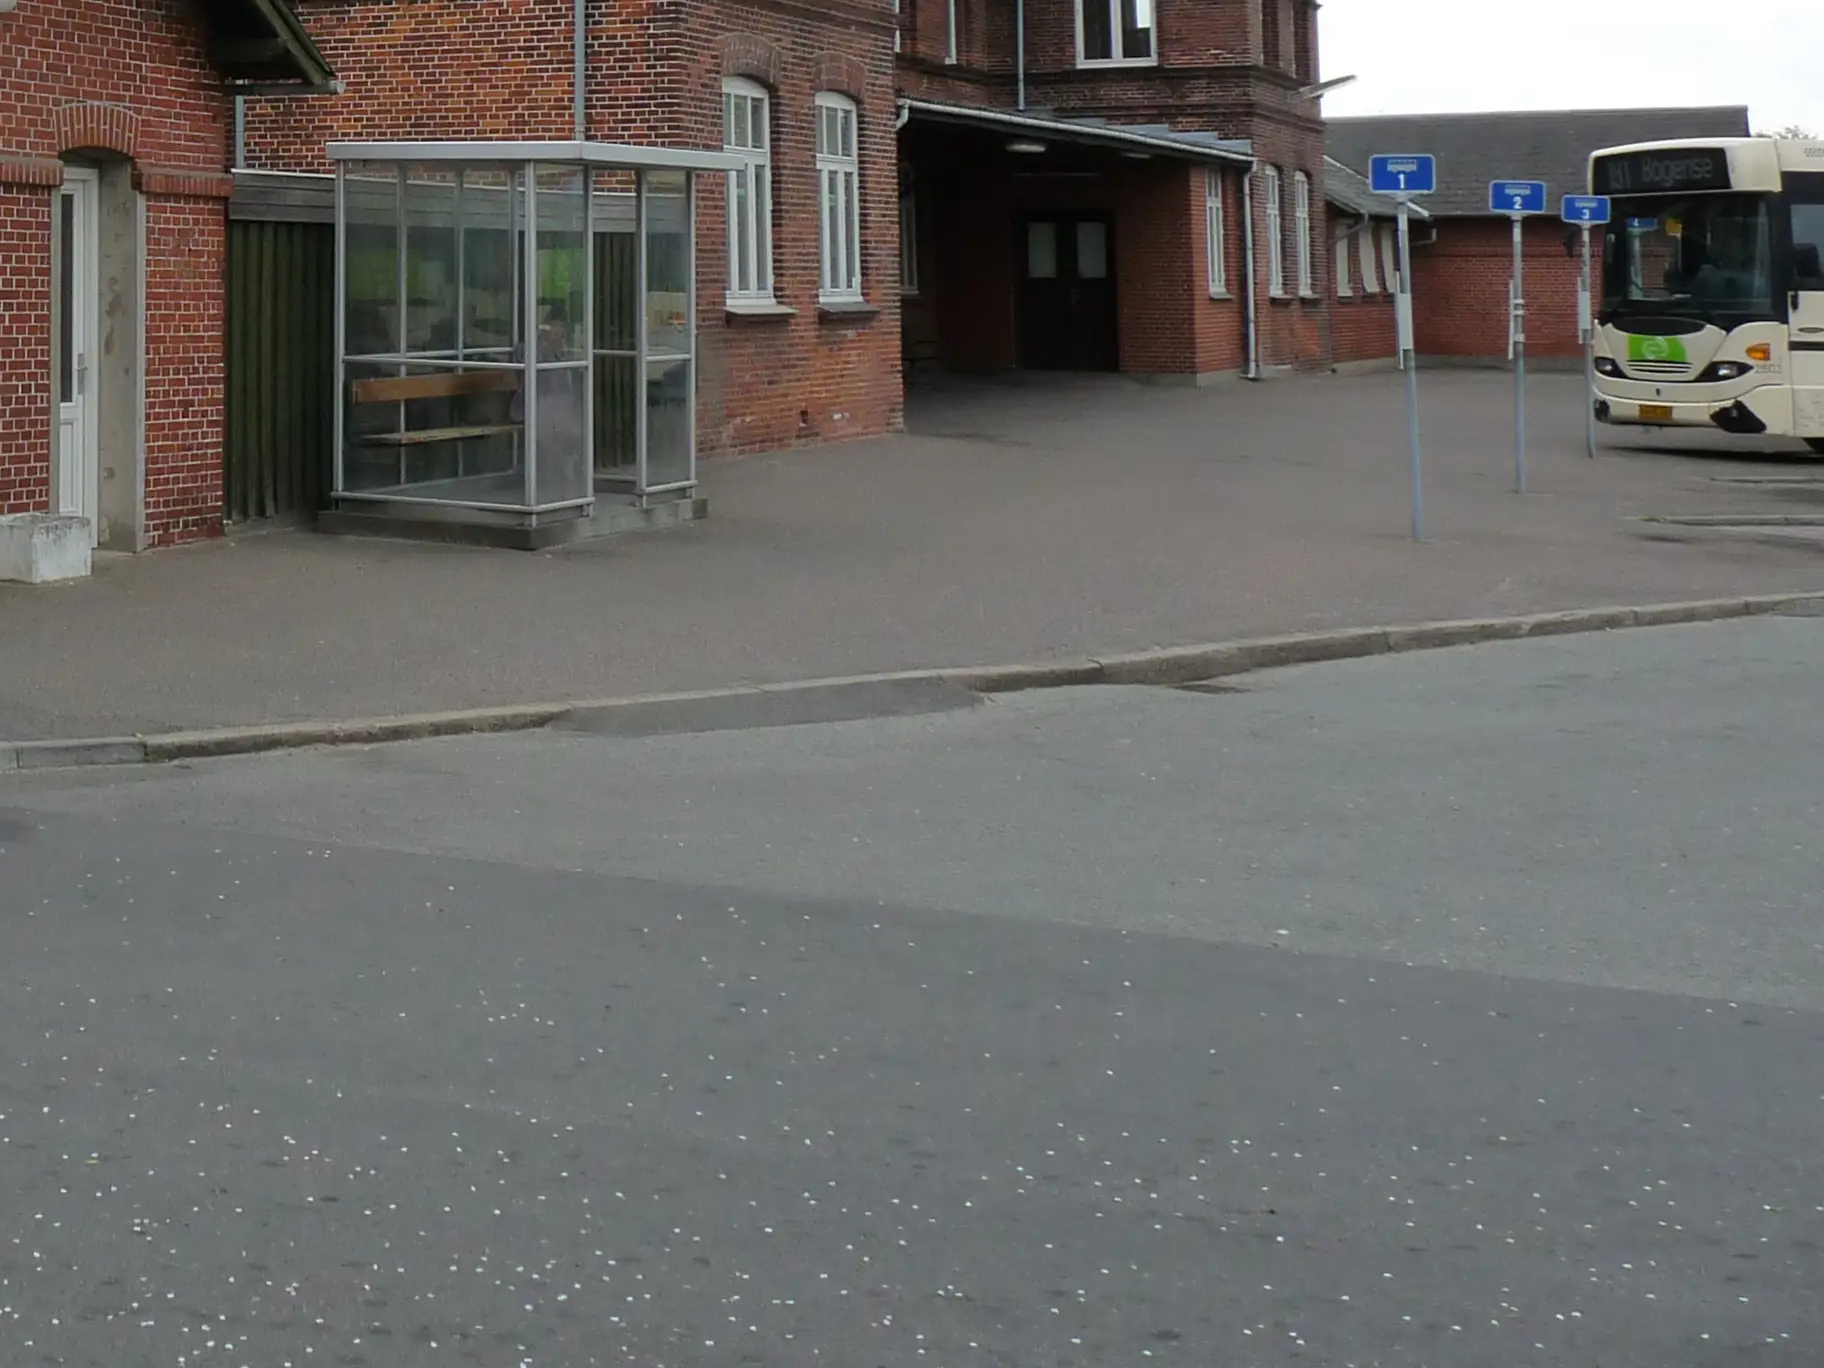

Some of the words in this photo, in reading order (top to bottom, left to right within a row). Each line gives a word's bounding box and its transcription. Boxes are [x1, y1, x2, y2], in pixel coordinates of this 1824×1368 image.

[1397, 173, 1405, 189] 1
[1512, 196, 1522, 209] 2
[1580, 209, 1590, 220] 3
